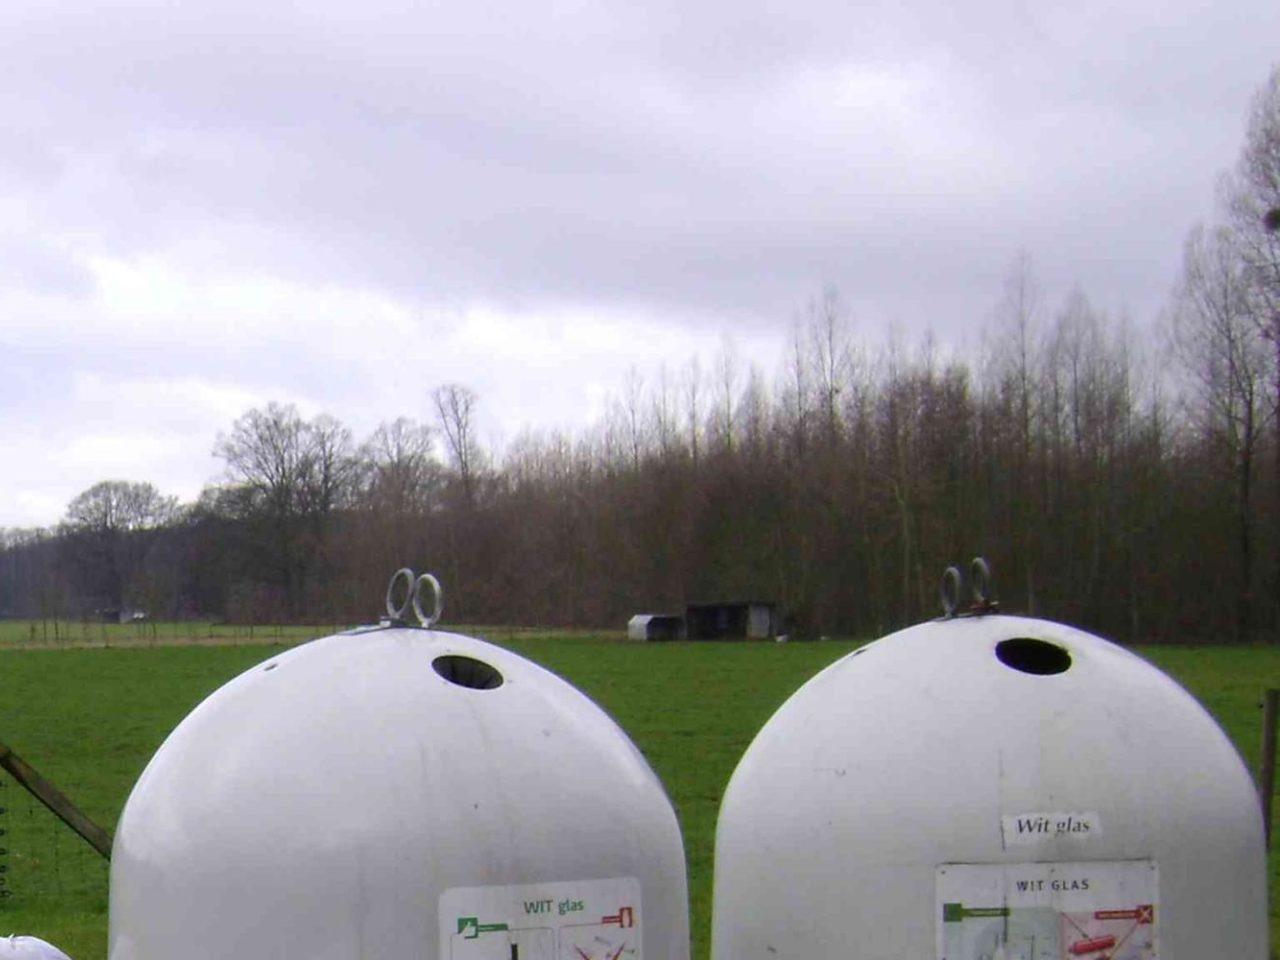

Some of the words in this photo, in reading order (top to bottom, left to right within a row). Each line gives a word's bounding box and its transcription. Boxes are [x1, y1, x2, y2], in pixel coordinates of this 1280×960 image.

[1017, 818, 1050, 834] Wit
[1055, 816, 1091, 835] glas
[1016, 880, 1045, 892] WIT
[1051, 878, 1090, 891] GLAS
[523, 899, 554, 915] WIT
[558, 897, 585, 916] glas
